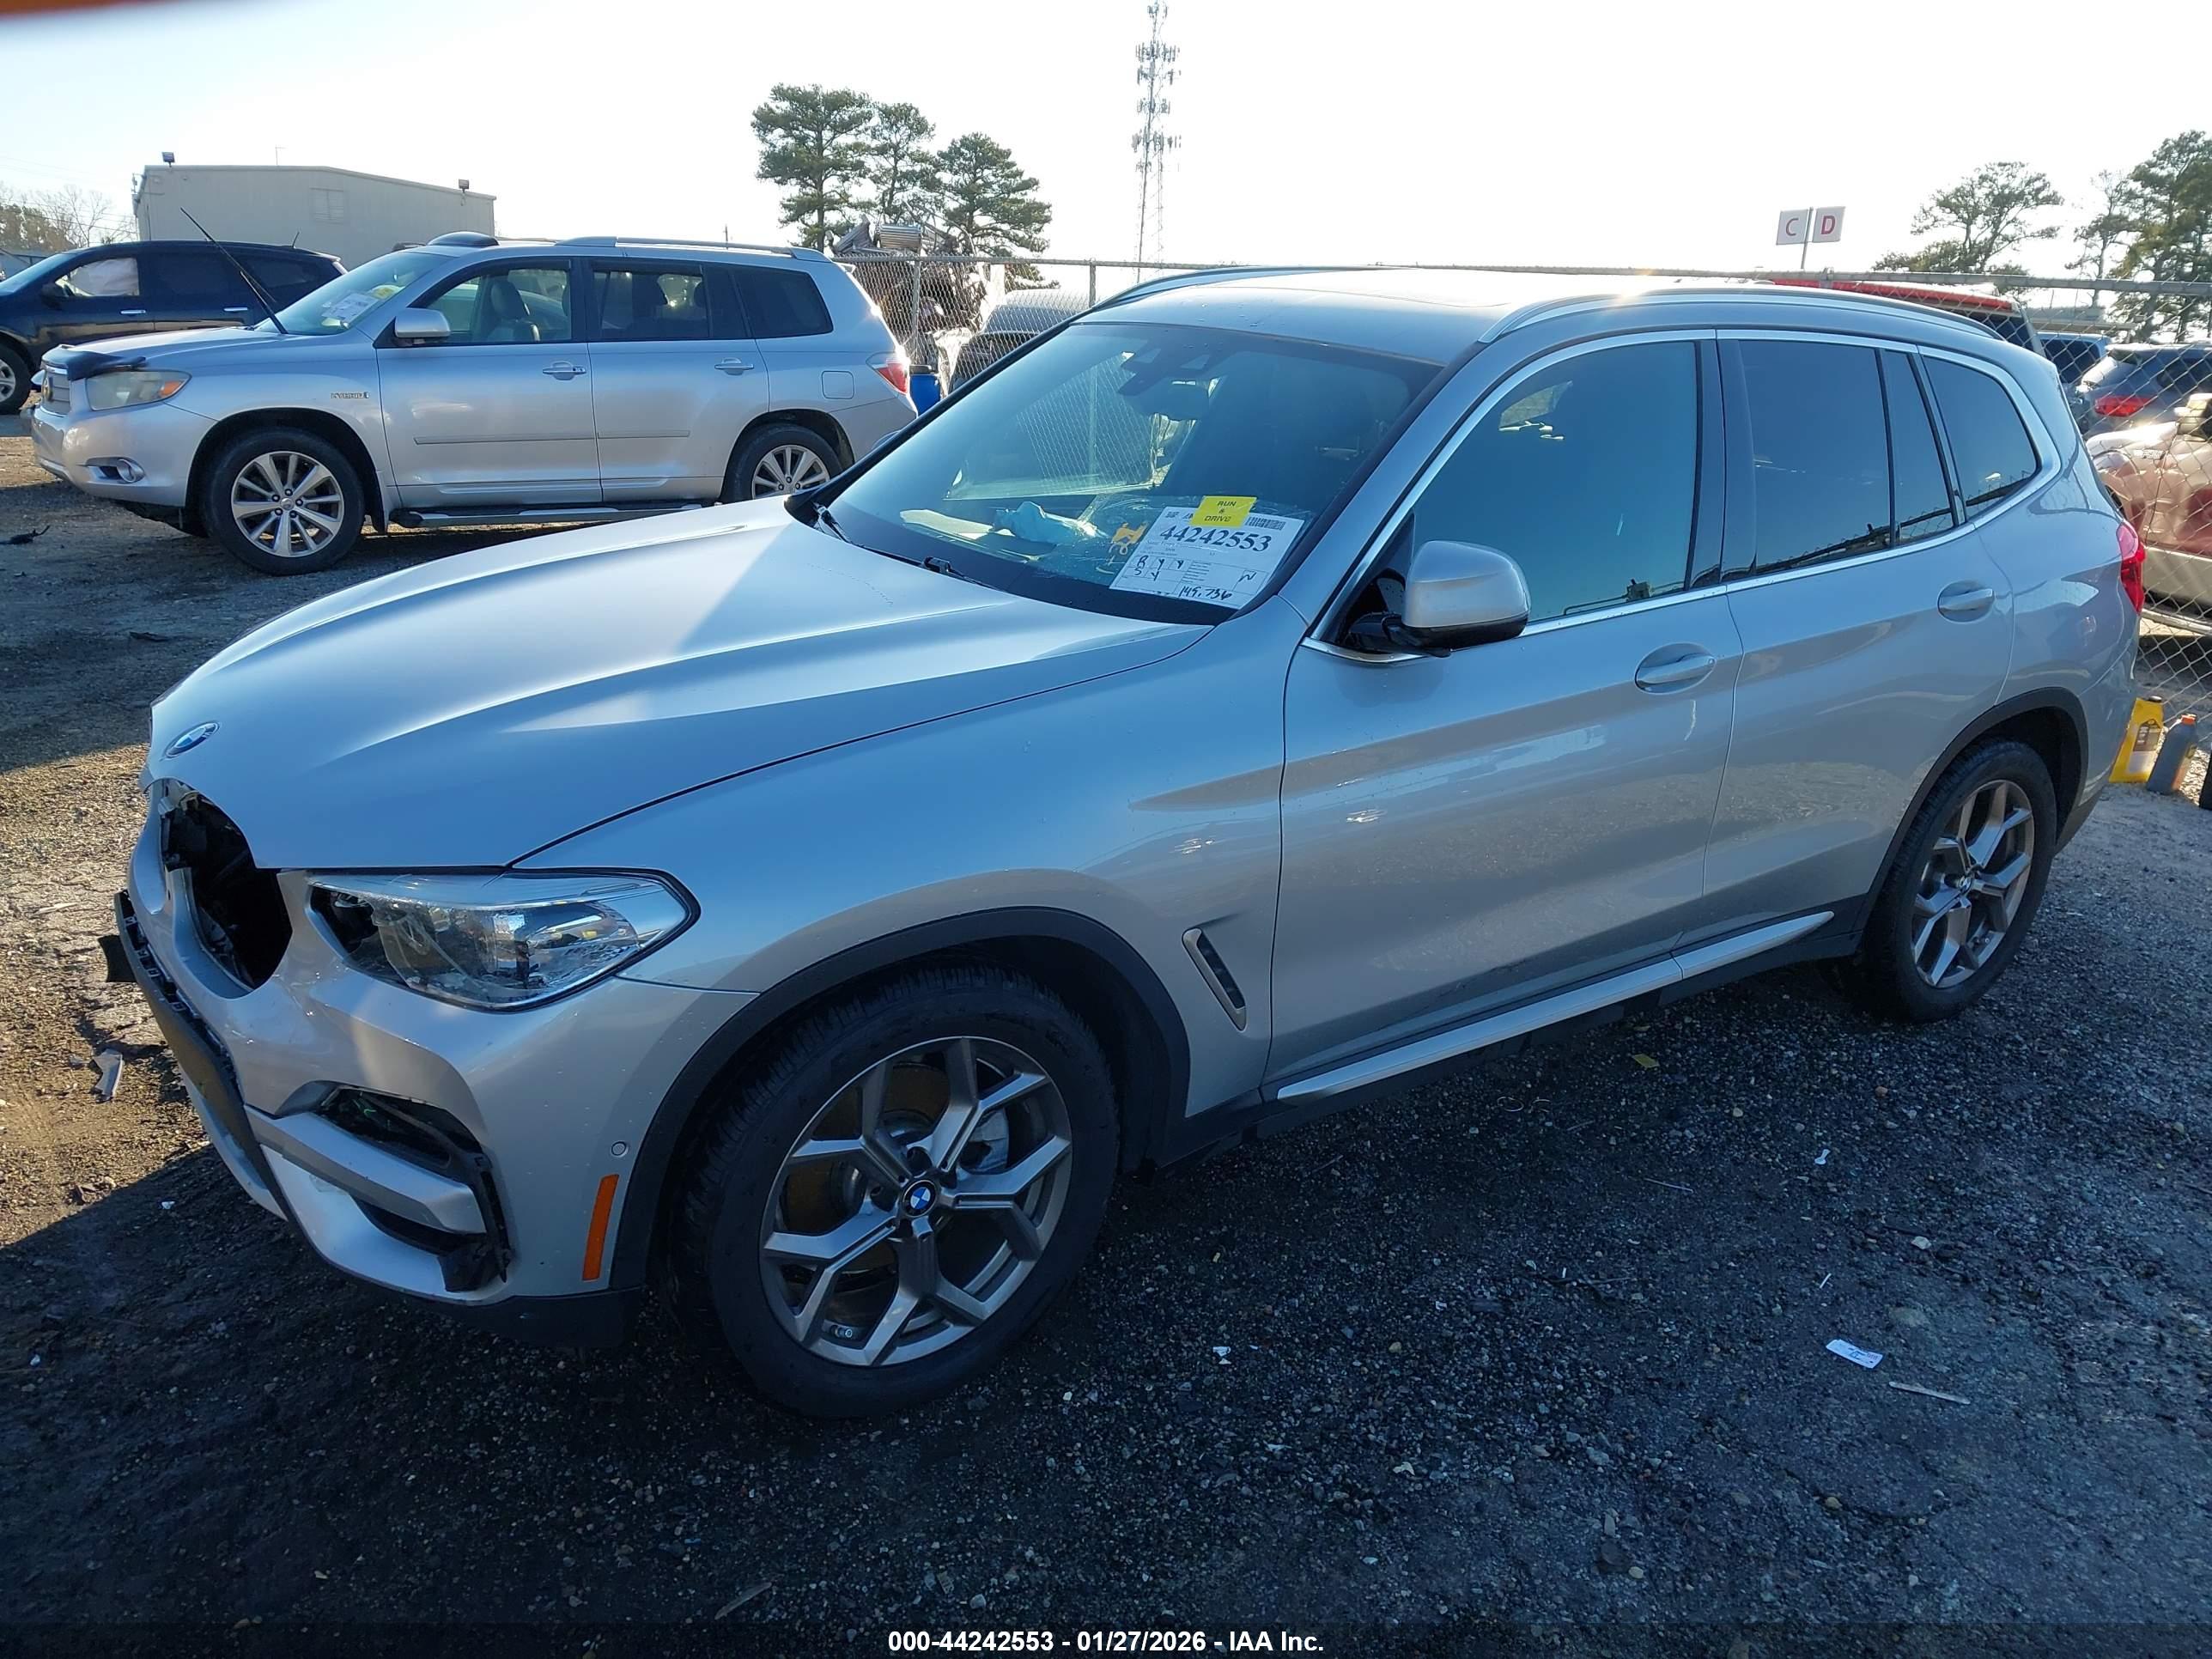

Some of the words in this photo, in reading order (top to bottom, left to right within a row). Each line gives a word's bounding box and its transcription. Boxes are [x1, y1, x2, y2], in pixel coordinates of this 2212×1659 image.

[1785, 217, 1799, 236] C
[1820, 215, 1836, 234] D
[1160, 525, 1272, 552] 44242553
